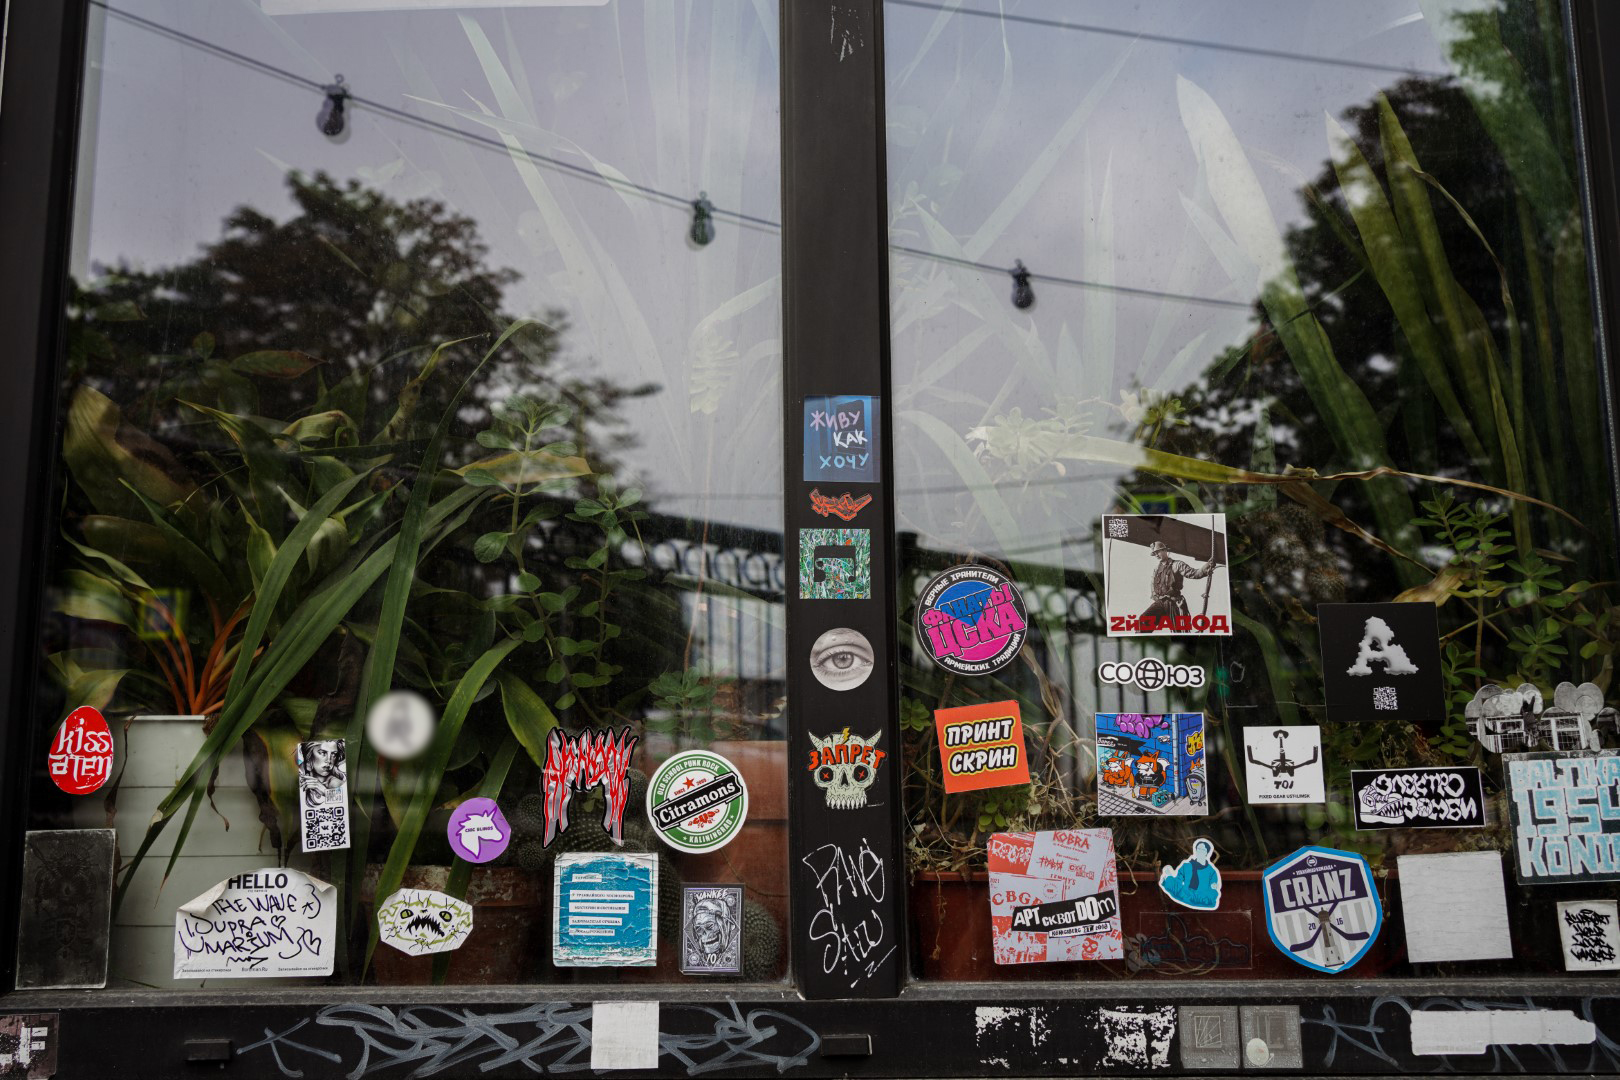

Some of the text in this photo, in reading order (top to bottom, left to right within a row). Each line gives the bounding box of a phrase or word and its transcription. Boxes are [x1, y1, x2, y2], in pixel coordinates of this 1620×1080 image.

[810, 410, 860, 431] ЖИВУ
[833, 429, 868, 448] КАК
[819, 453, 869, 469] ХОЧУ
[925, 570, 999, 606] ВЕРНЫЕ ХРАНИТЕЛИ
[922, 582, 1015, 628] ФАНАТЫ
[925, 601, 1027, 659] ЦСКА
[944, 656, 990, 672] АРМЕЙСКИХ
[945, 718, 1014, 747] ПРИНТ
[808, 743, 886, 771] ЗАПРЕТ
[950, 745, 1018, 774] СКРИН
[657, 759, 720, 796] OLD SCHOOL PUNK ROCK
[1371, 773, 1465, 798] ЭЛЕКТРО
[1509, 757, 1620, 793] BALTIKA
[659, 782, 736, 823] Citramons
[689, 819, 733, 843] KALININGRAD
[1053, 831, 1089, 849] KOBRA
[228, 873, 288, 890] HELLO
[1280, 868, 1356, 909] CRANZ
